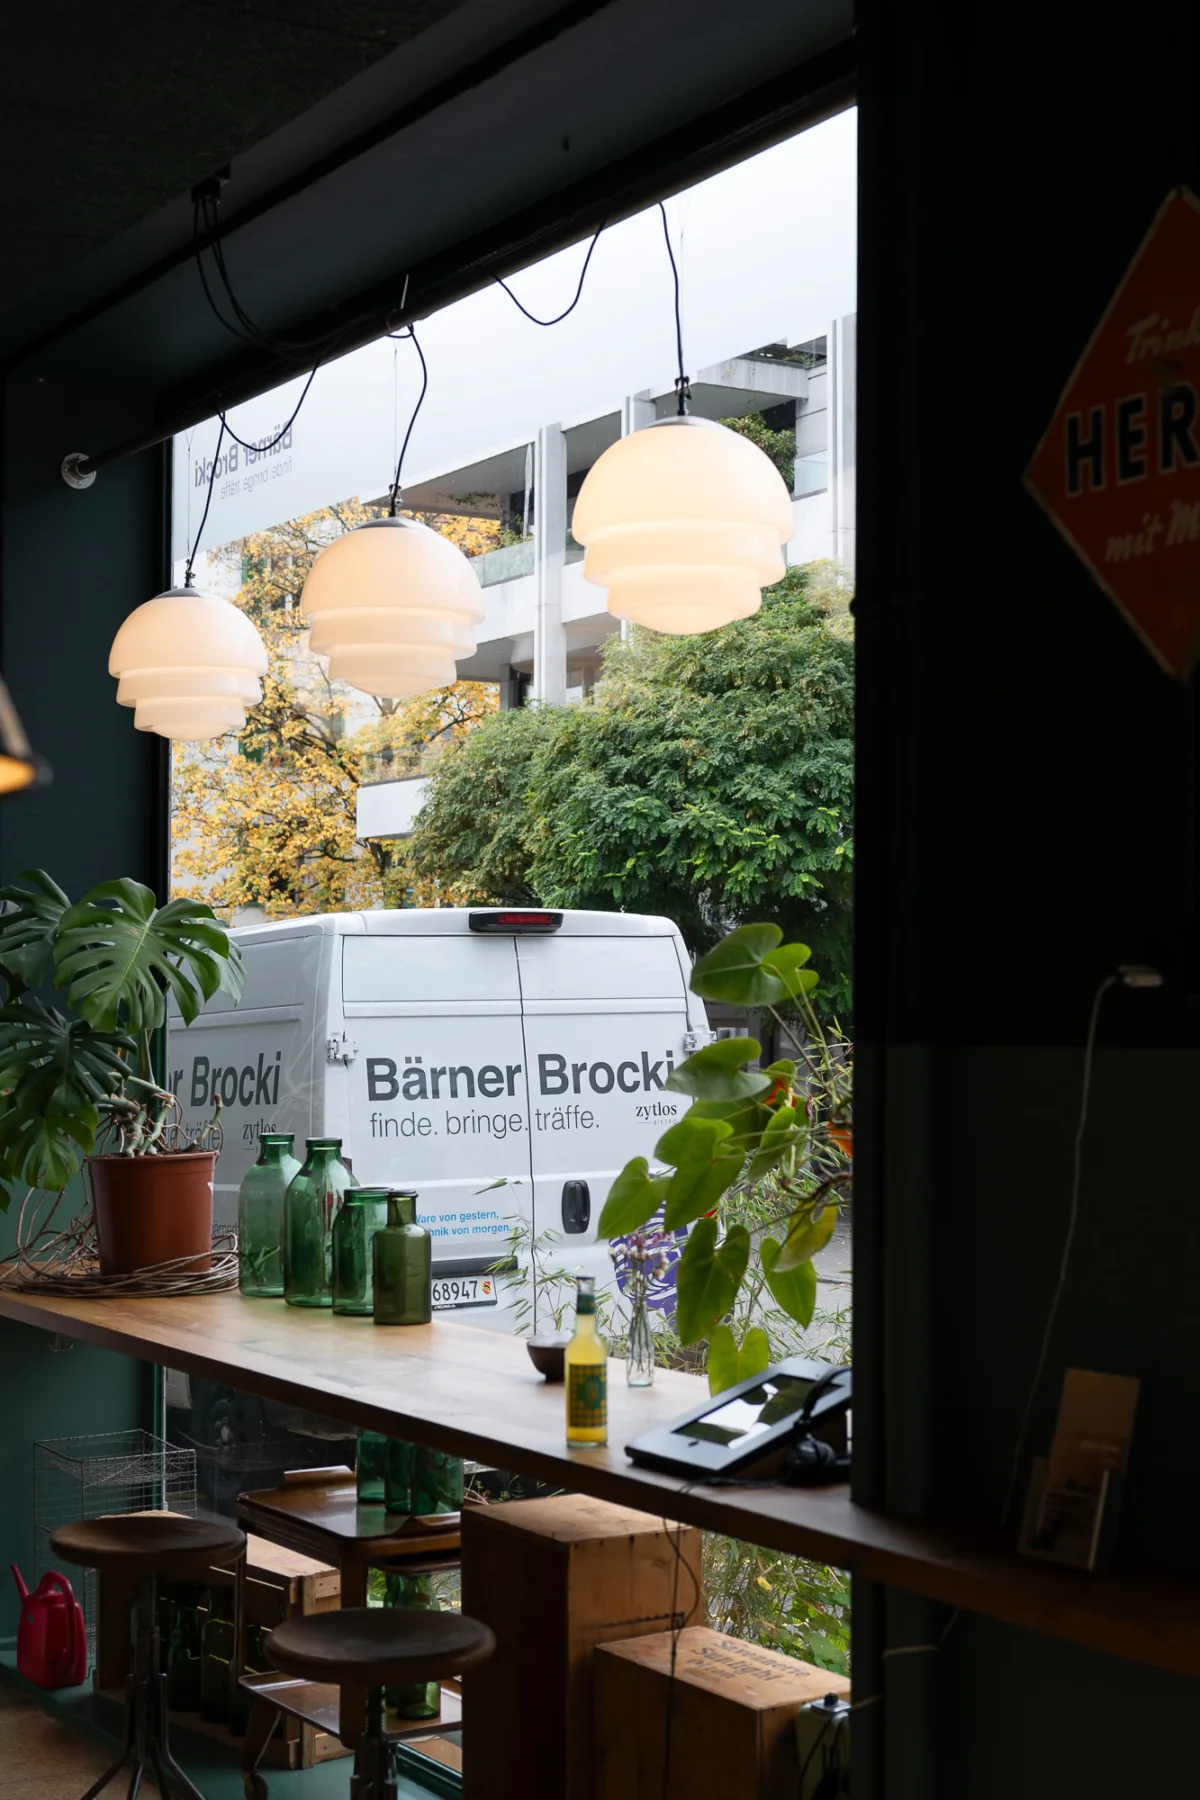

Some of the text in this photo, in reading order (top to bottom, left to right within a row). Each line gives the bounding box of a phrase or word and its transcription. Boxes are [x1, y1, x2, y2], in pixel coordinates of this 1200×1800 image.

[1105, 511, 1163, 563] mit
[190, 1050, 282, 1108] Brocki
[366, 1050, 675, 1101] Bärner Brocki
[370, 1104, 600, 1139] finde. bringe. träffe.
[636, 1101, 678, 1120] zytlos
[439, 1213, 457, 1222] von
[460, 1210, 500, 1223] gestern,
[429, 1226, 449, 1237] hnik
[452, 1227, 470, 1235] von
[433, 1280, 478, 1301] 68947
